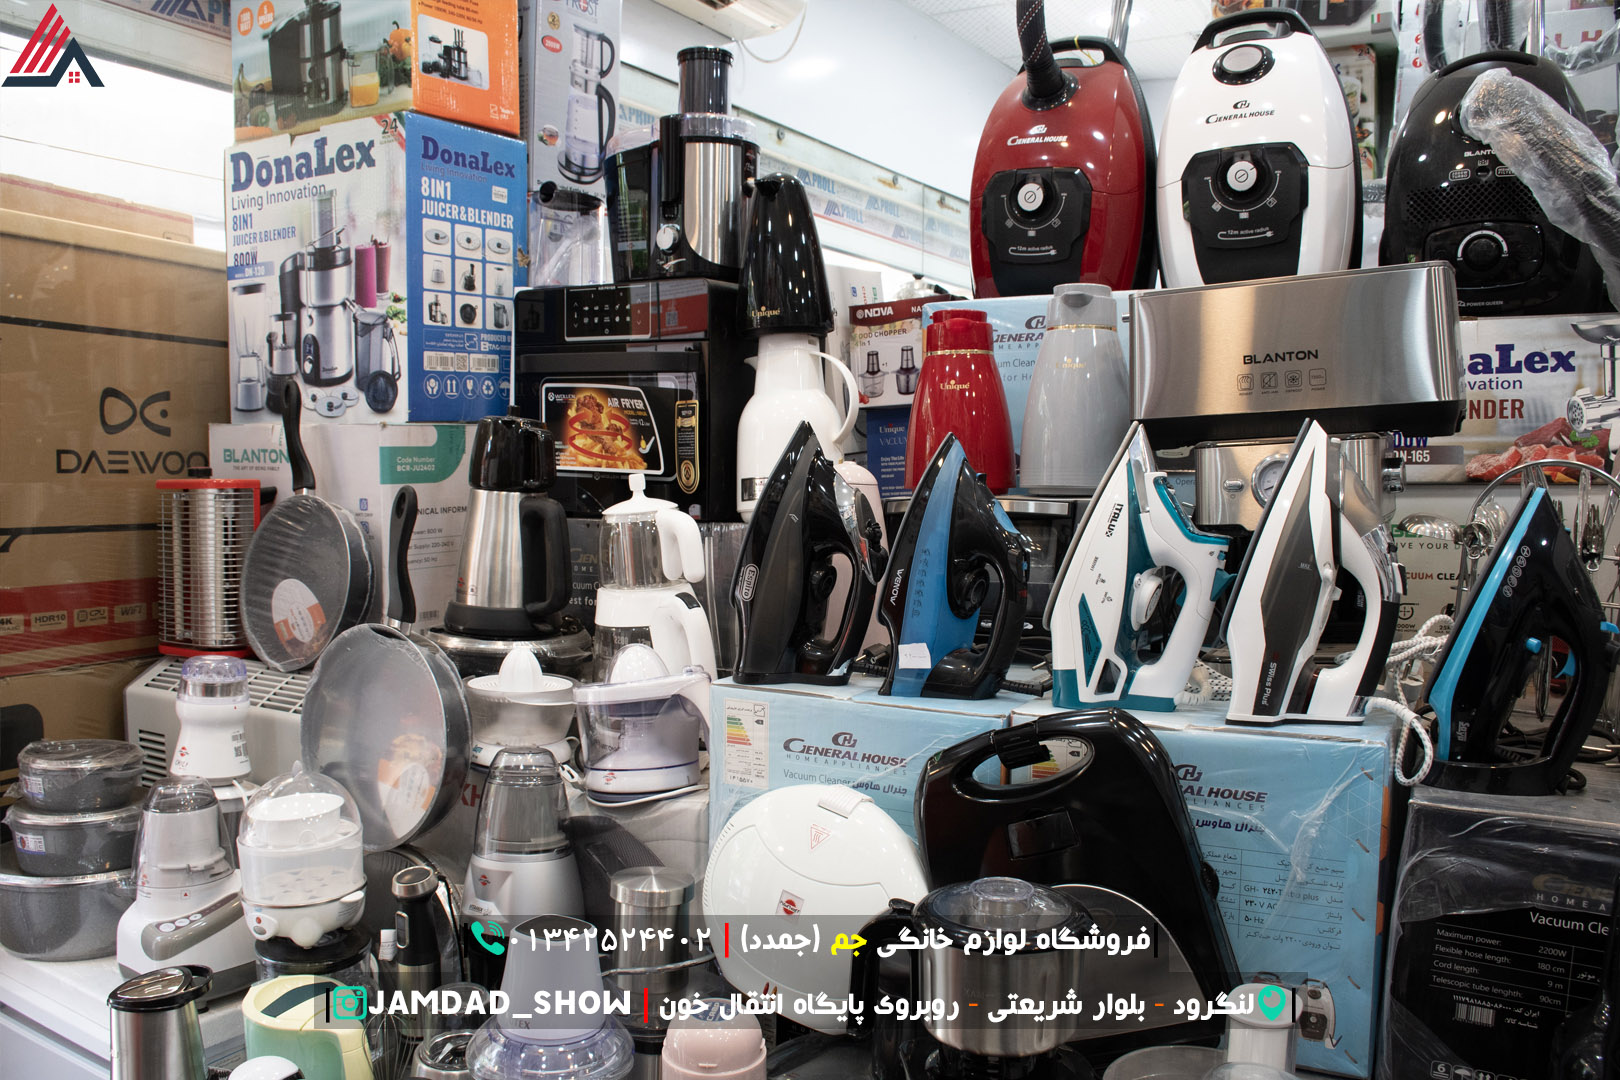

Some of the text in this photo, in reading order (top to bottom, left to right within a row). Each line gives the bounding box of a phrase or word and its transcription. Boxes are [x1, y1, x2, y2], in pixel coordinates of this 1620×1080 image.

[1205, 109, 1275, 124] GENERAL HOUSE
[381, 118, 398, 135] 24
[231, 182, 327, 212] Living Innovation
[233, 251, 258, 268] 800W
[864, 306, 894, 318] NOVA
[874, 328, 908, 338] CHOPPER
[1012, 359, 1036, 368] Clean
[1243, 349, 1319, 365] BLANTON
[1468, 343, 1576, 373] aLex
[1468, 377, 1523, 390] vation
[607, 397, 645, 410] AIR FRYER
[1468, 399, 1525, 420] NDER
[223, 447, 290, 464] BLANTON
[396, 456, 413, 464] Code
[1175, 478, 1196, 486] Opera
[417, 505, 468, 515] NICAL INFORM
[1105, 503, 1124, 538] ITALUX
[1419, 542, 1449, 550] YOUR
[572, 582, 593, 590] cuum
[889, 567, 906, 606] WENOW
[34, 613, 67, 624] HDR10
[783, 737, 908, 768] GENERAL HOUSE
[786, 754, 819, 764] HOME
[783, 768, 817, 783] Vacuum
[1207, 788, 1268, 803] HOUSE
[1193, 798, 1266, 812] LIANCES
[1303, 893, 1319, 903] plus
[1253, 916, 1265, 924] Hz
[1529, 911, 1610, 936] Vacuum Cle
[1436, 928, 1474, 941] Maximum
[1538, 945, 1568, 958] 2200W
[1435, 944, 1463, 956] Flexible
[1464, 949, 1484, 959] hose
[1537, 962, 1551, 971] 180
[1552, 965, 1566, 974] cm
[1433, 959, 1452, 969] Cord
[1547, 980, 1553, 988] 9
[1554, 982, 1563, 990] m
[1432, 974, 1471, 988] Telescopic
[1472, 982, 1490, 992] tube
[1437, 1064, 1446, 1072] 6
